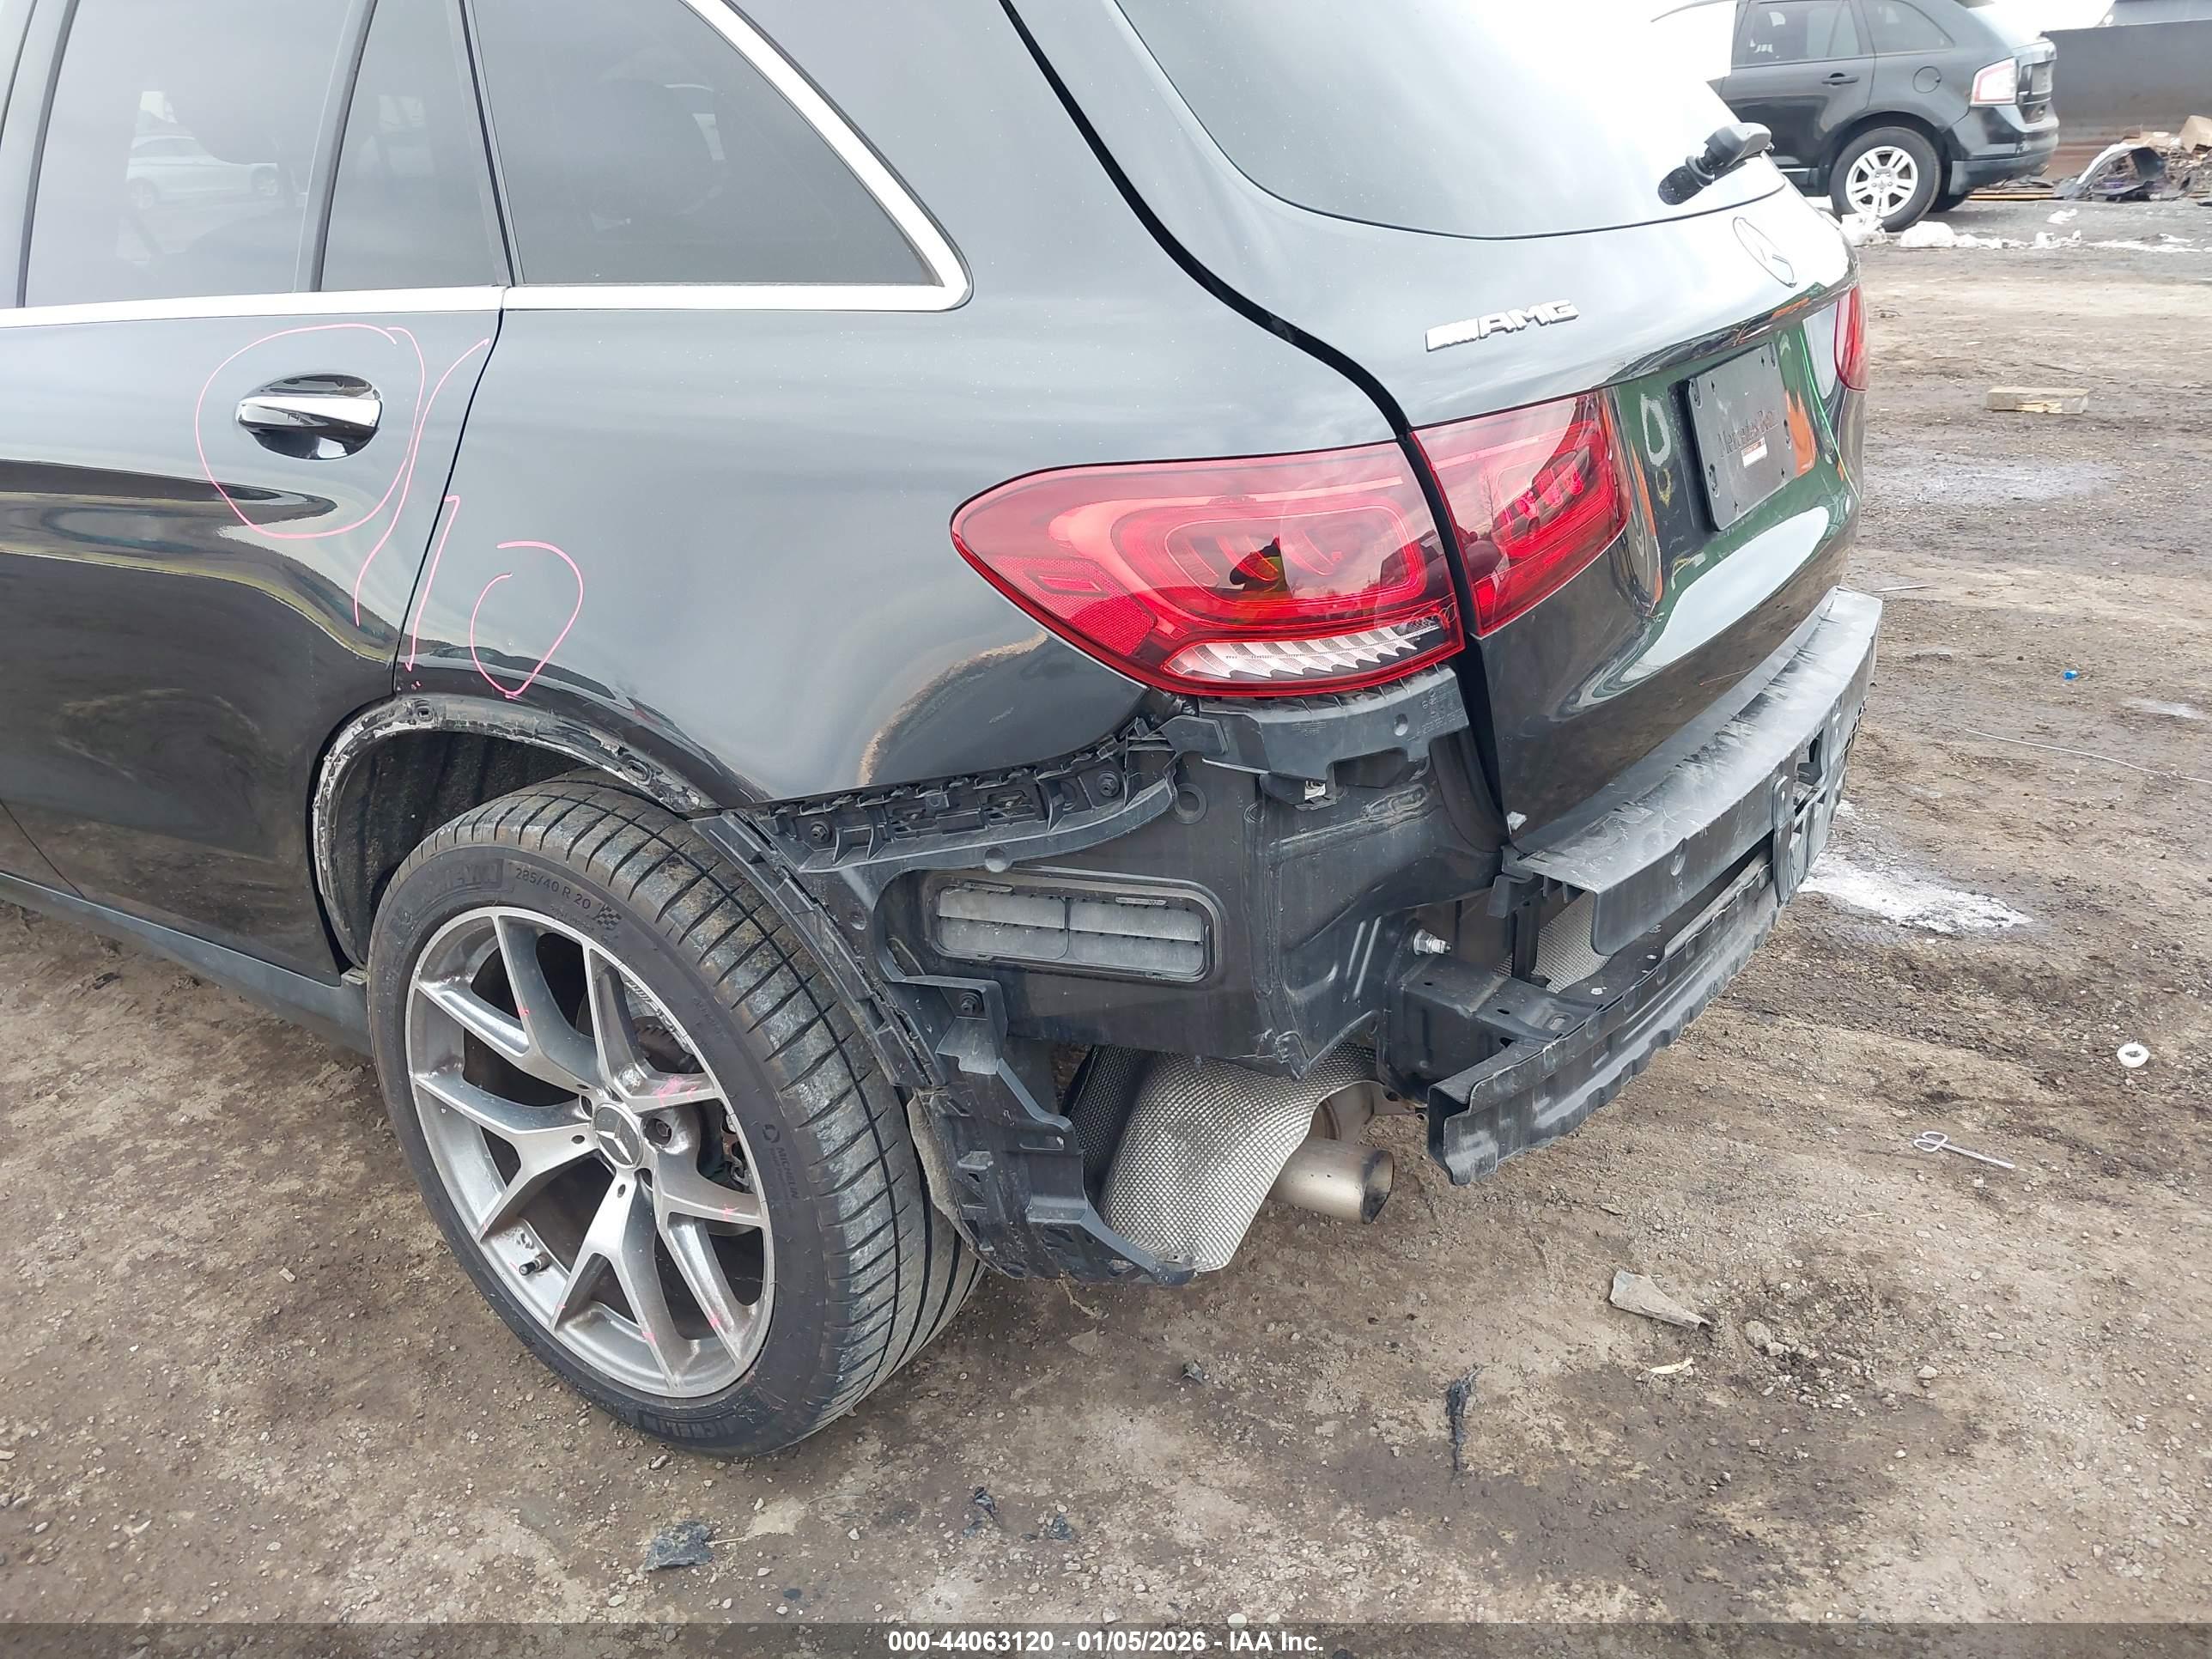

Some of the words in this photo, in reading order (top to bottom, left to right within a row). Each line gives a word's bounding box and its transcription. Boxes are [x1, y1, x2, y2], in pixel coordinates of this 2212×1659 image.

[1477, 299, 1580, 339] AMG
[515, 866, 559, 894] 285/40
[561, 885, 572, 900] R
[573, 893, 592, 910] 20
[775, 1146, 799, 1200] MICHELIN
